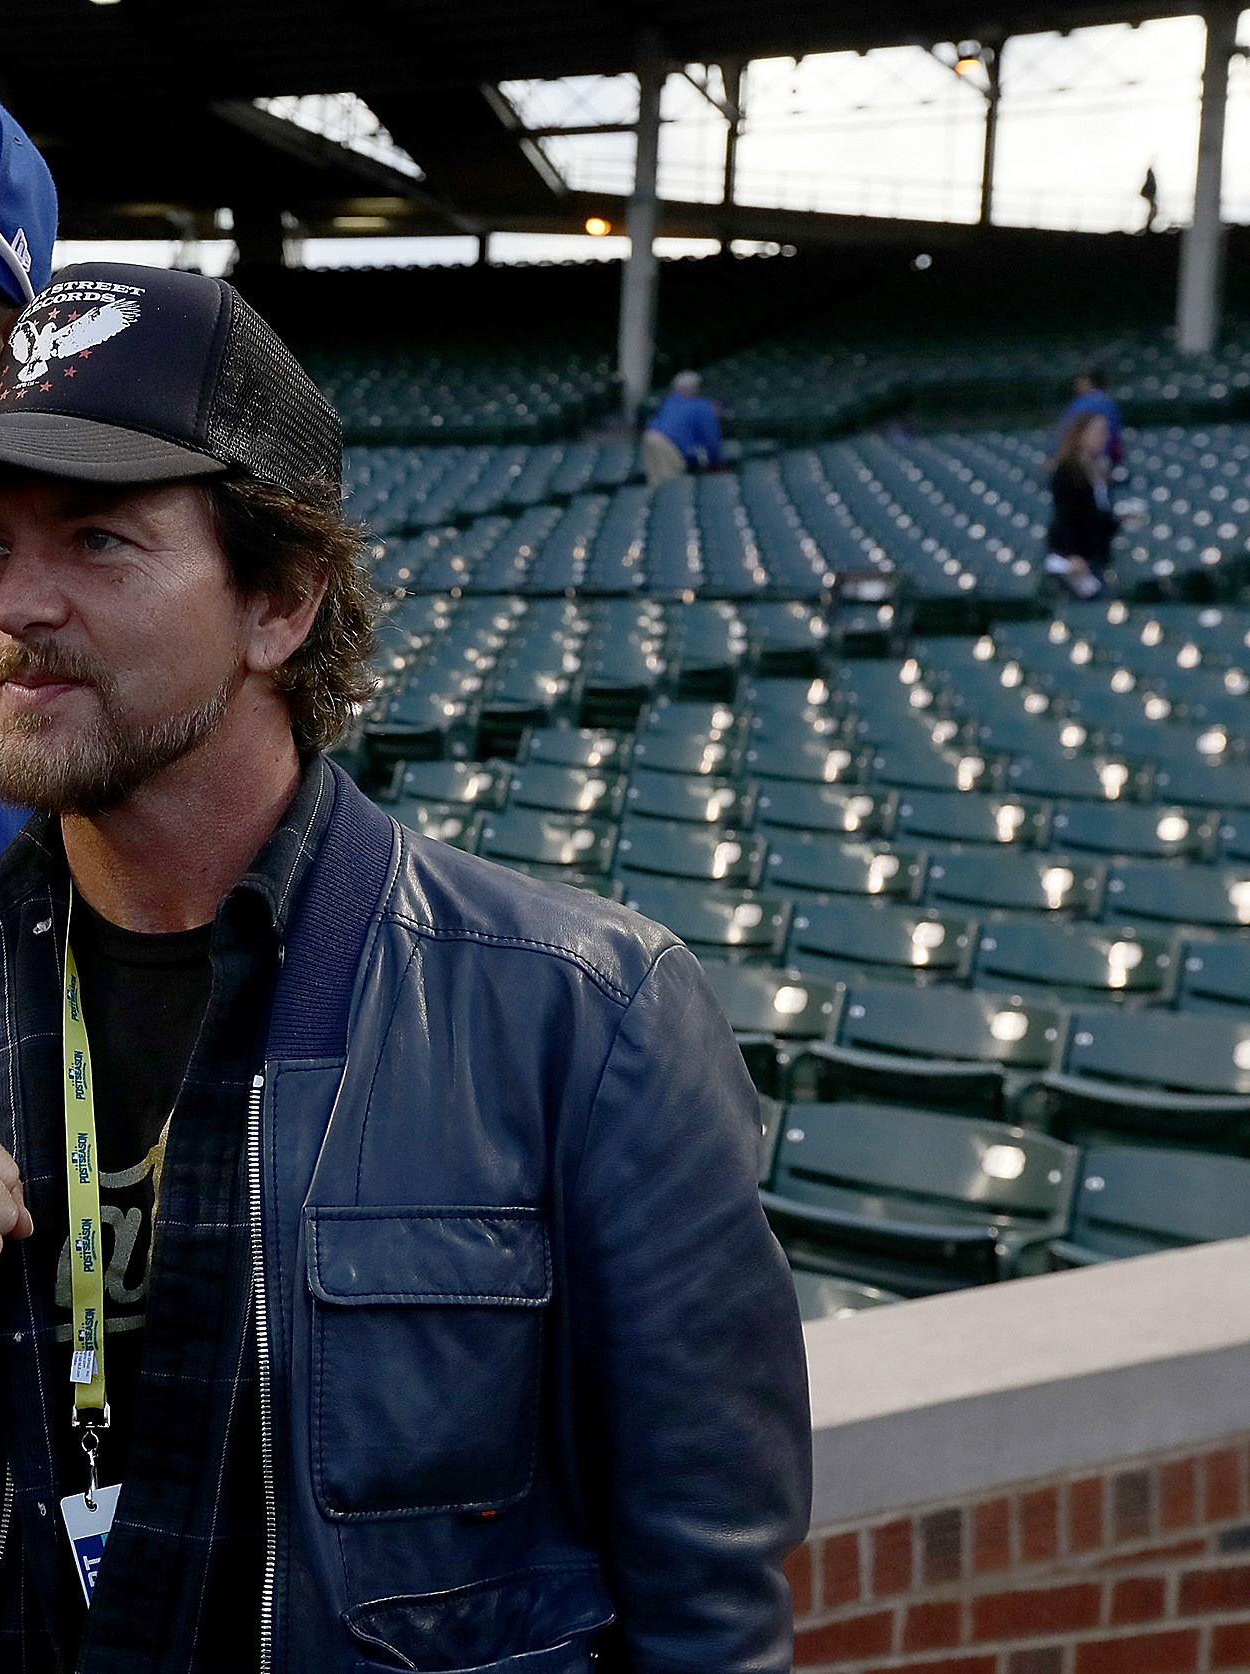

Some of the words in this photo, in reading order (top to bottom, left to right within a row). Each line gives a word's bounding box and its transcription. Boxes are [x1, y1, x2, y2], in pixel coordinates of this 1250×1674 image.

[51, 281, 146, 297] STREET
[74, 1050, 85, 1100] POSTSEASON
[78, 1133, 90, 1184] POSTSEASON
[82, 1219, 94, 1272] POSTSEASON
